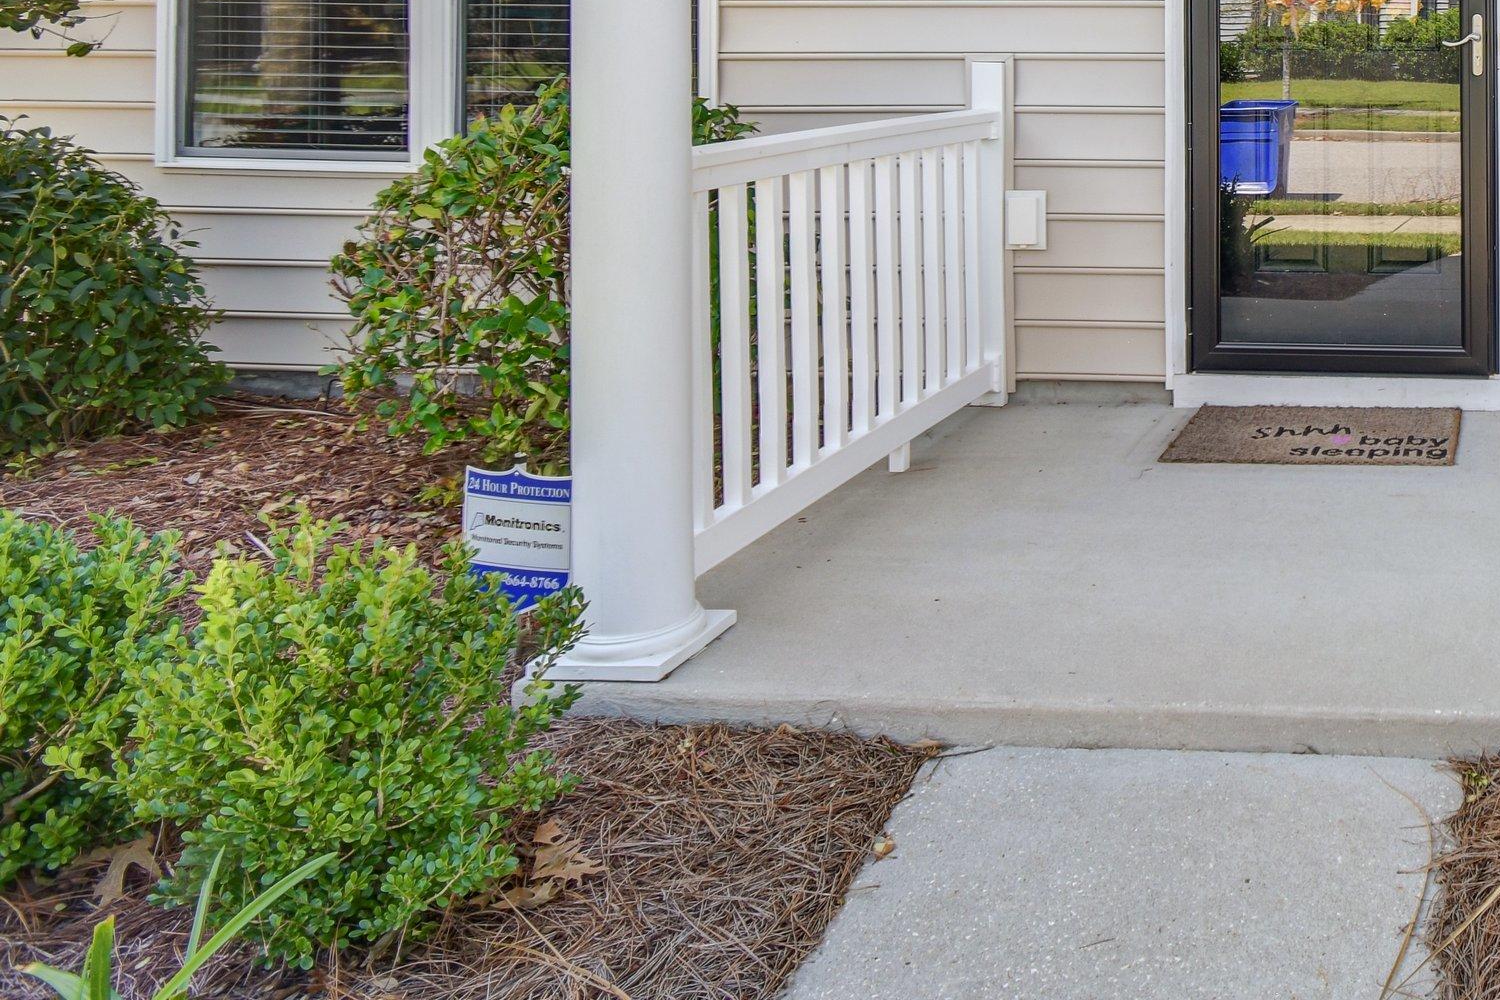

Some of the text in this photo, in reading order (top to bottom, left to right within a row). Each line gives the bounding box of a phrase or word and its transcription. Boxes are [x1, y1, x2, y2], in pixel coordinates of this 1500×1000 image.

[1358, 435, 1449, 448] baby
[467, 476, 480, 490] 24
[485, 514, 561, 532] Monitronics
[504, 537, 532, 549] Security
[533, 540, 564, 551] Systems
